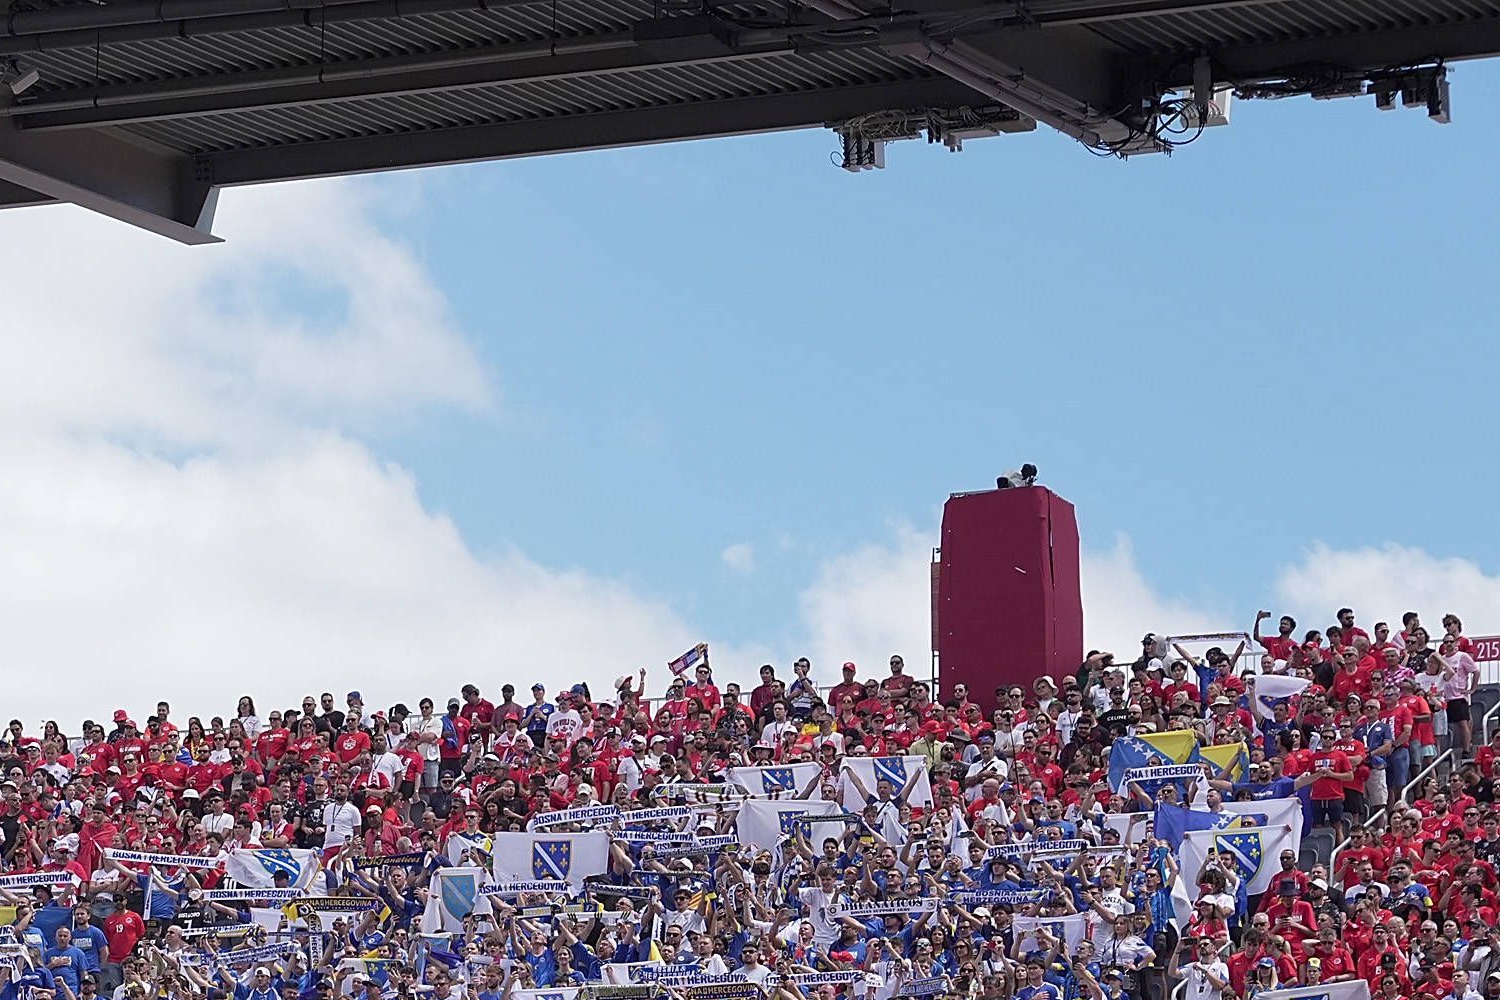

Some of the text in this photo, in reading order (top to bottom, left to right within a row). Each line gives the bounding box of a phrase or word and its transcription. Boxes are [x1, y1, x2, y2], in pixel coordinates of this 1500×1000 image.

[1477, 642, 1499, 659] 215
[210, 889, 301, 899] BOSNA HERCEGOVINA
